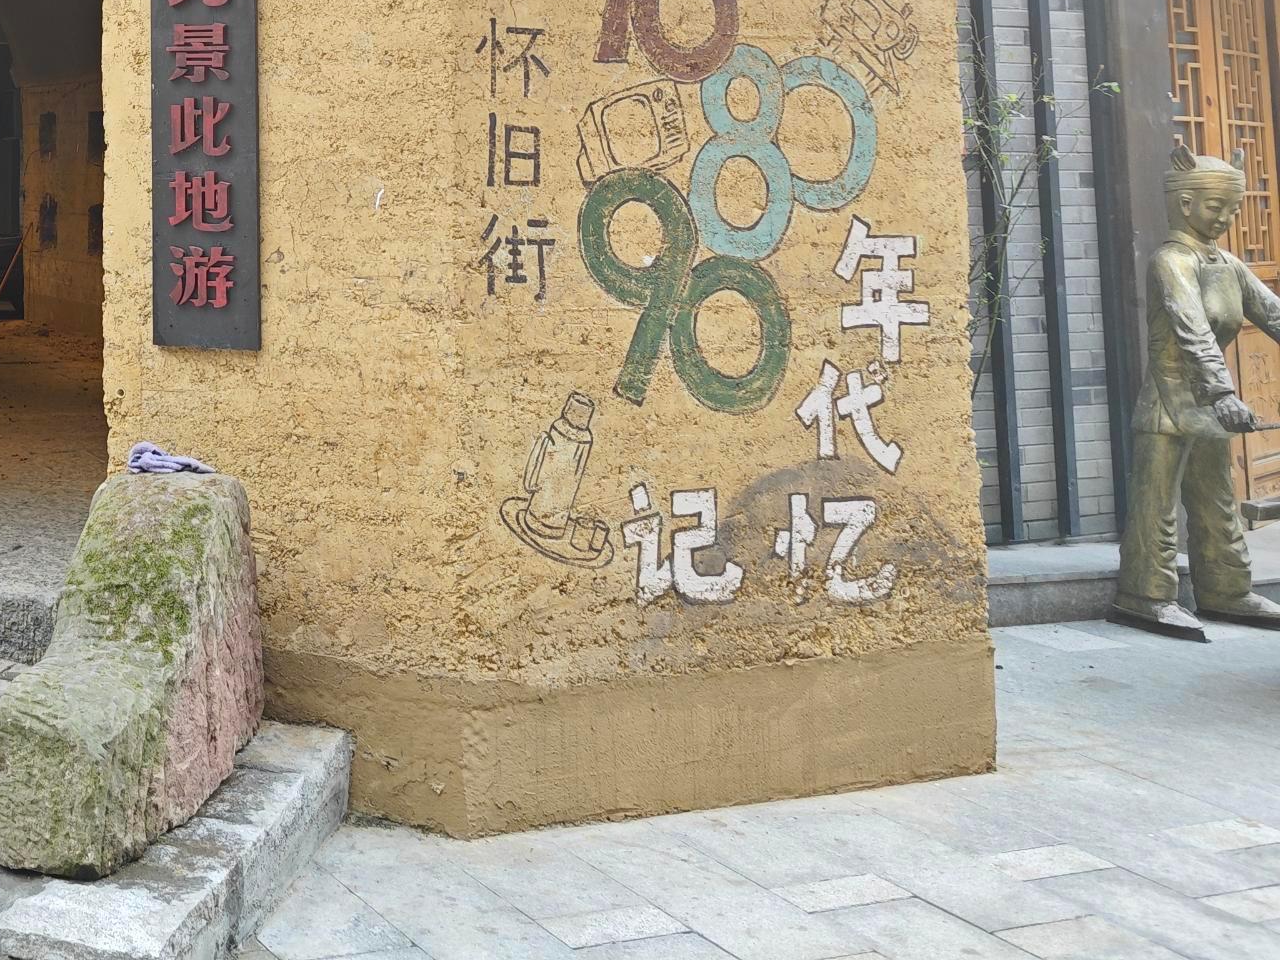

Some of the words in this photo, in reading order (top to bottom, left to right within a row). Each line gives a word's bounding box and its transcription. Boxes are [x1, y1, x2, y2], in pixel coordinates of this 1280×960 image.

[476, 18, 556, 301] 怀旧街
[689, 44, 877, 261] 80
[578, 167, 791, 413] 90
[795, 215, 930, 474] 年代
[621, 482, 897, 607] 记忆
